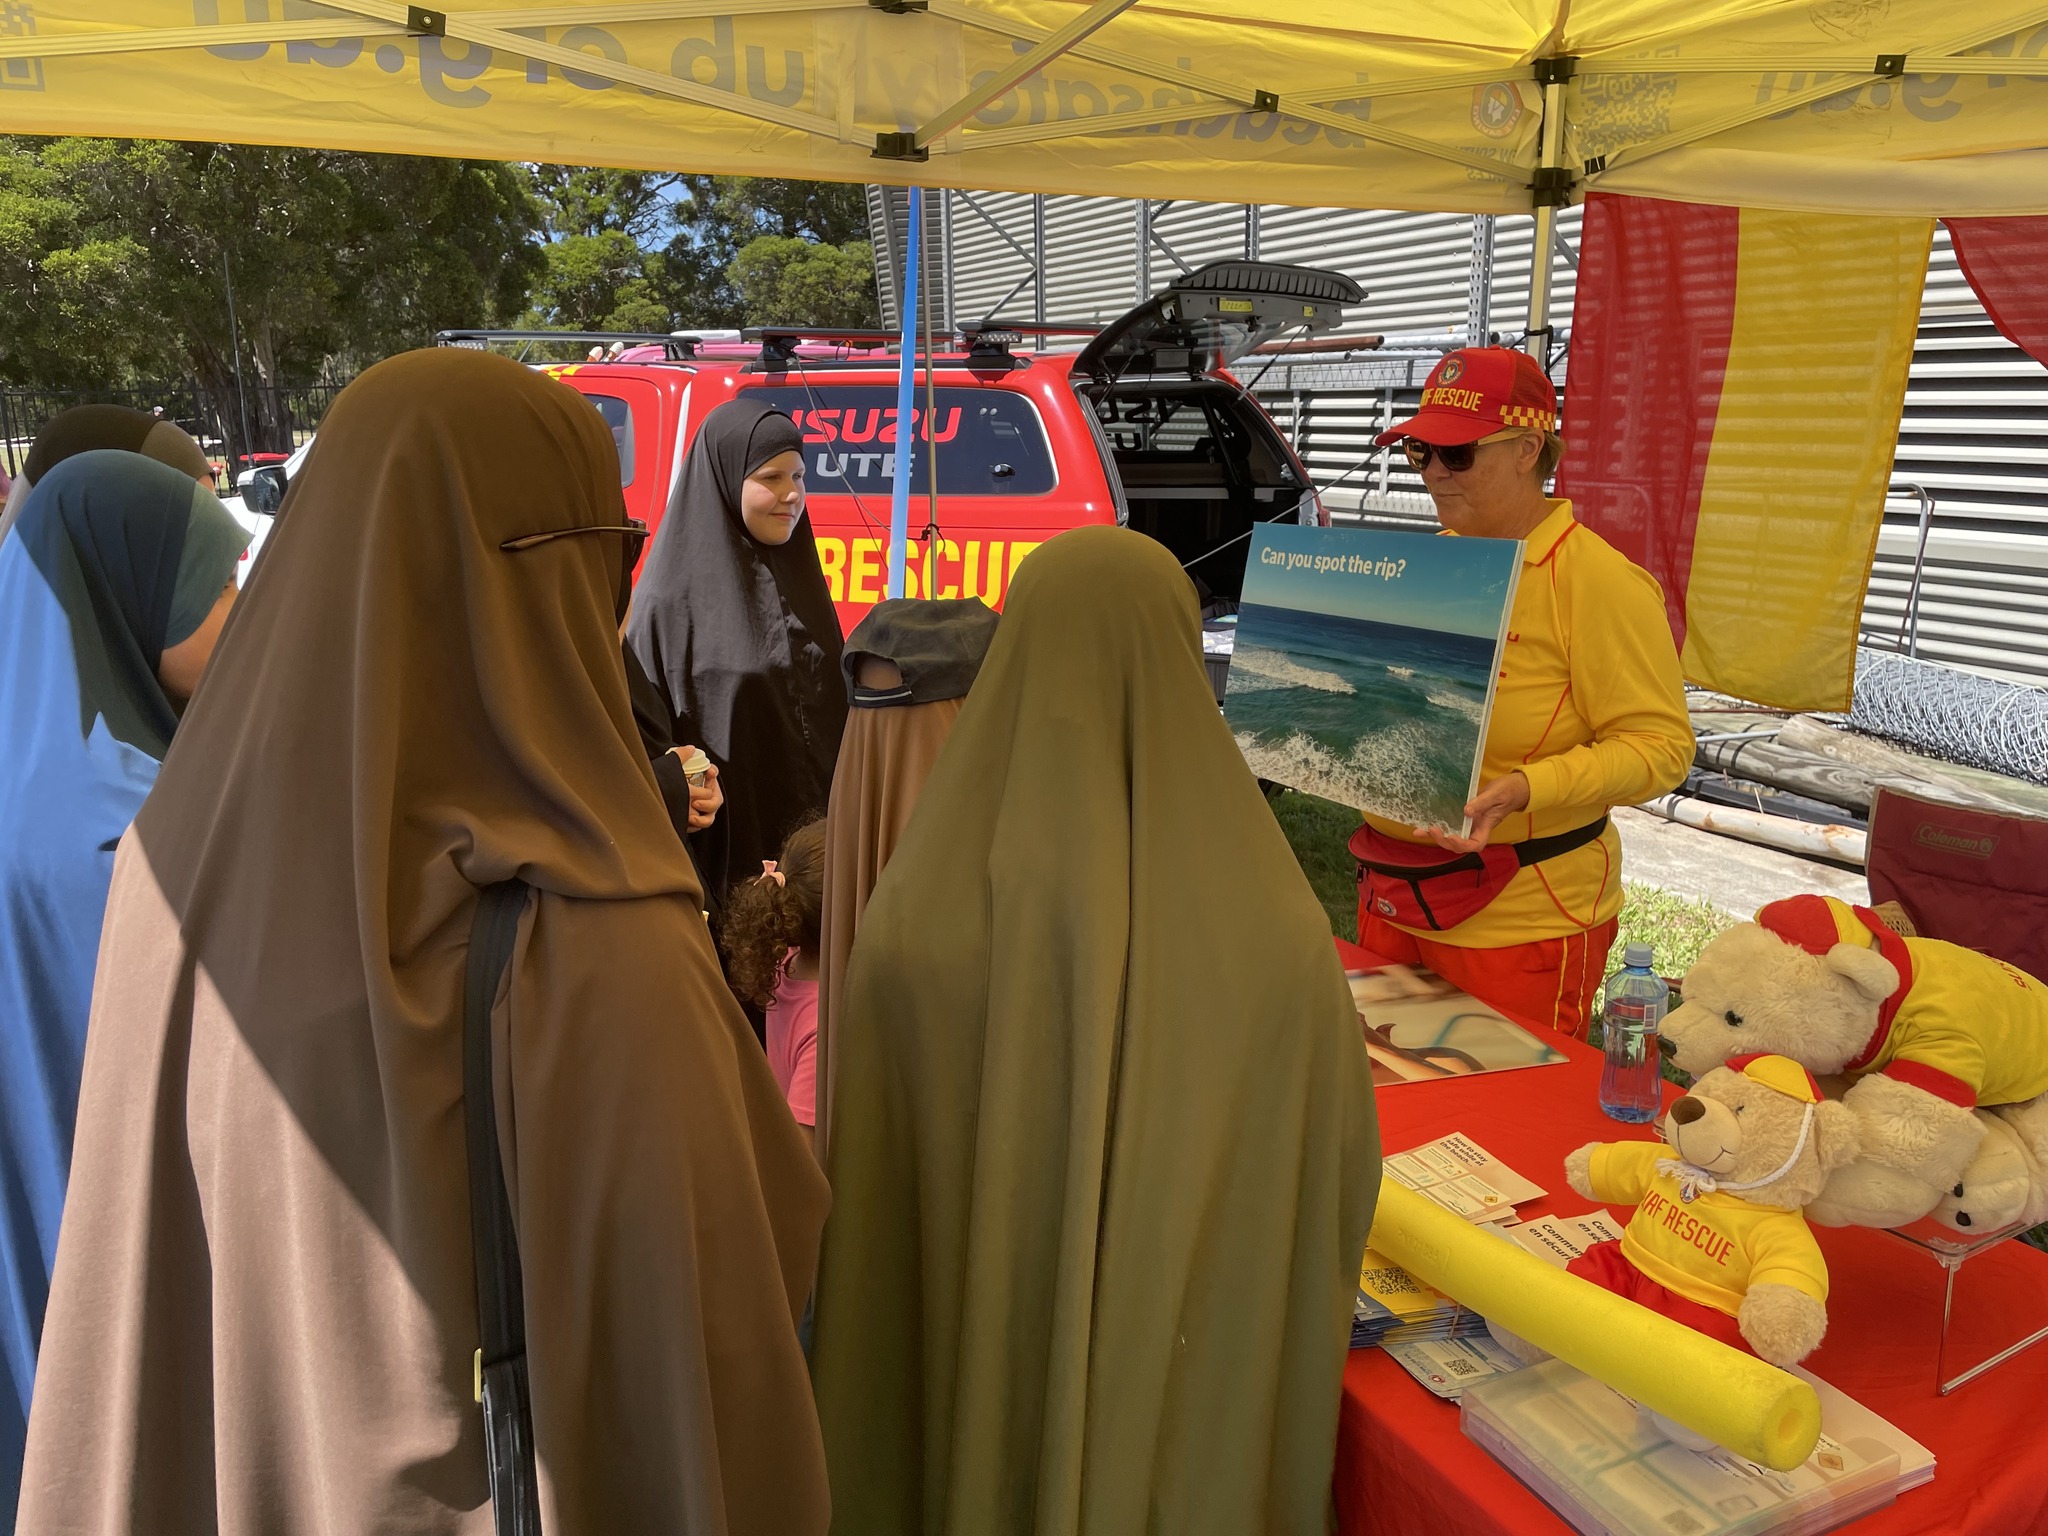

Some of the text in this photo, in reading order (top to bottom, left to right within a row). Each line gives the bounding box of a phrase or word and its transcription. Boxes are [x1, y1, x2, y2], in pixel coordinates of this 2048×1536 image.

[1431, 387, 1484, 412] RESCUE
[1261, 546, 1407, 581] Can you spot the rip?
[1919, 825, 1979, 851] Coleman
[1529, 1228, 1543, 1239] en
[1578, 1222, 1592, 1233] en
[1662, 1203, 1736, 1267] RESCUE
